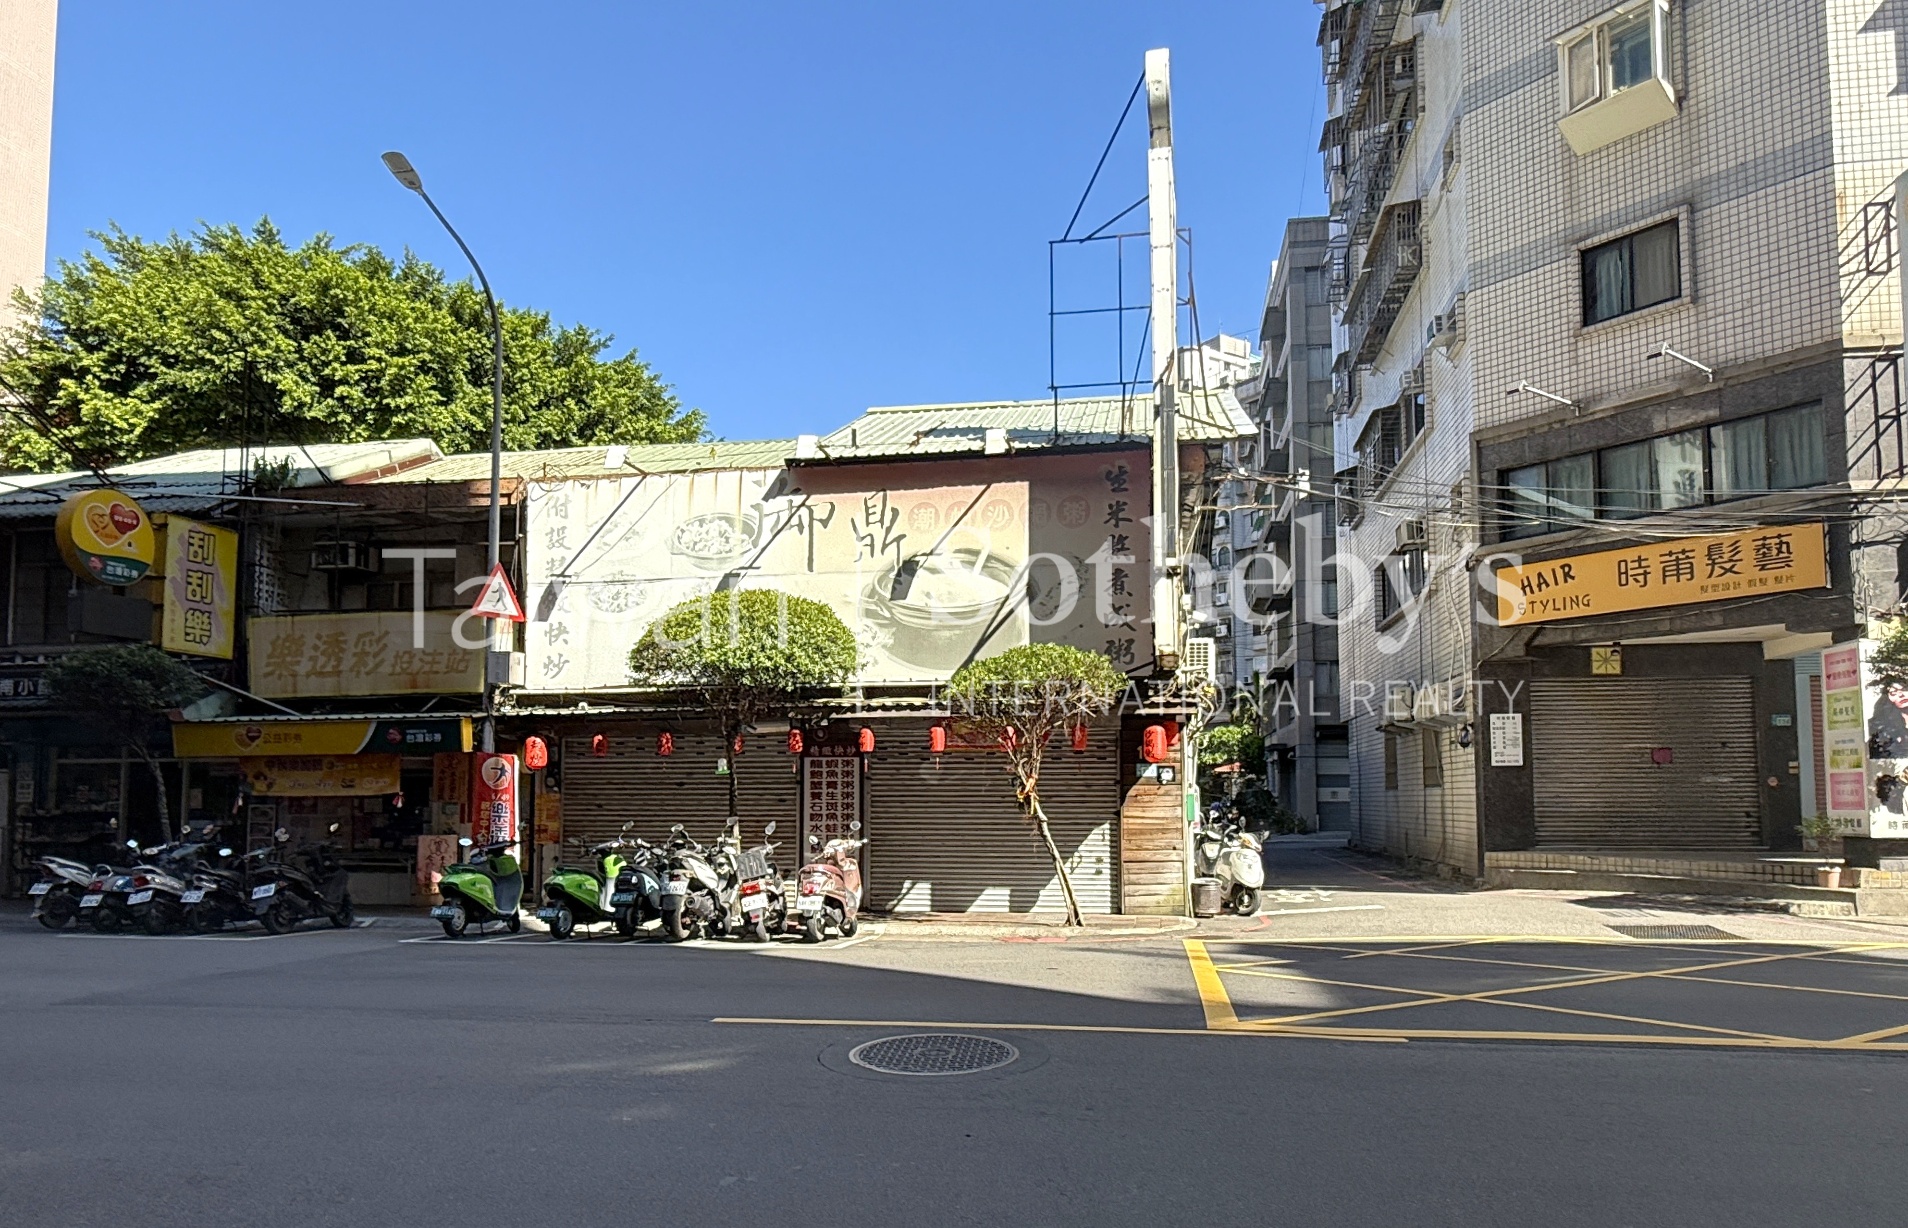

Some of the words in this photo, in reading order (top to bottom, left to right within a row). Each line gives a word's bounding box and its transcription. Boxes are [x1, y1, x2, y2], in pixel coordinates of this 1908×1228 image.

[1520, 563, 1576, 596] HAIR
[183, 529, 216, 646] 刮刮樂
[1517, 594, 1592, 615] STYLING
[809, 759, 855, 769] 龍蝦粥
[809, 770, 855, 780] 鮑魚粥
[809, 791, 855, 801] 養生粥
[809, 802, 855, 811] 石斑粥
